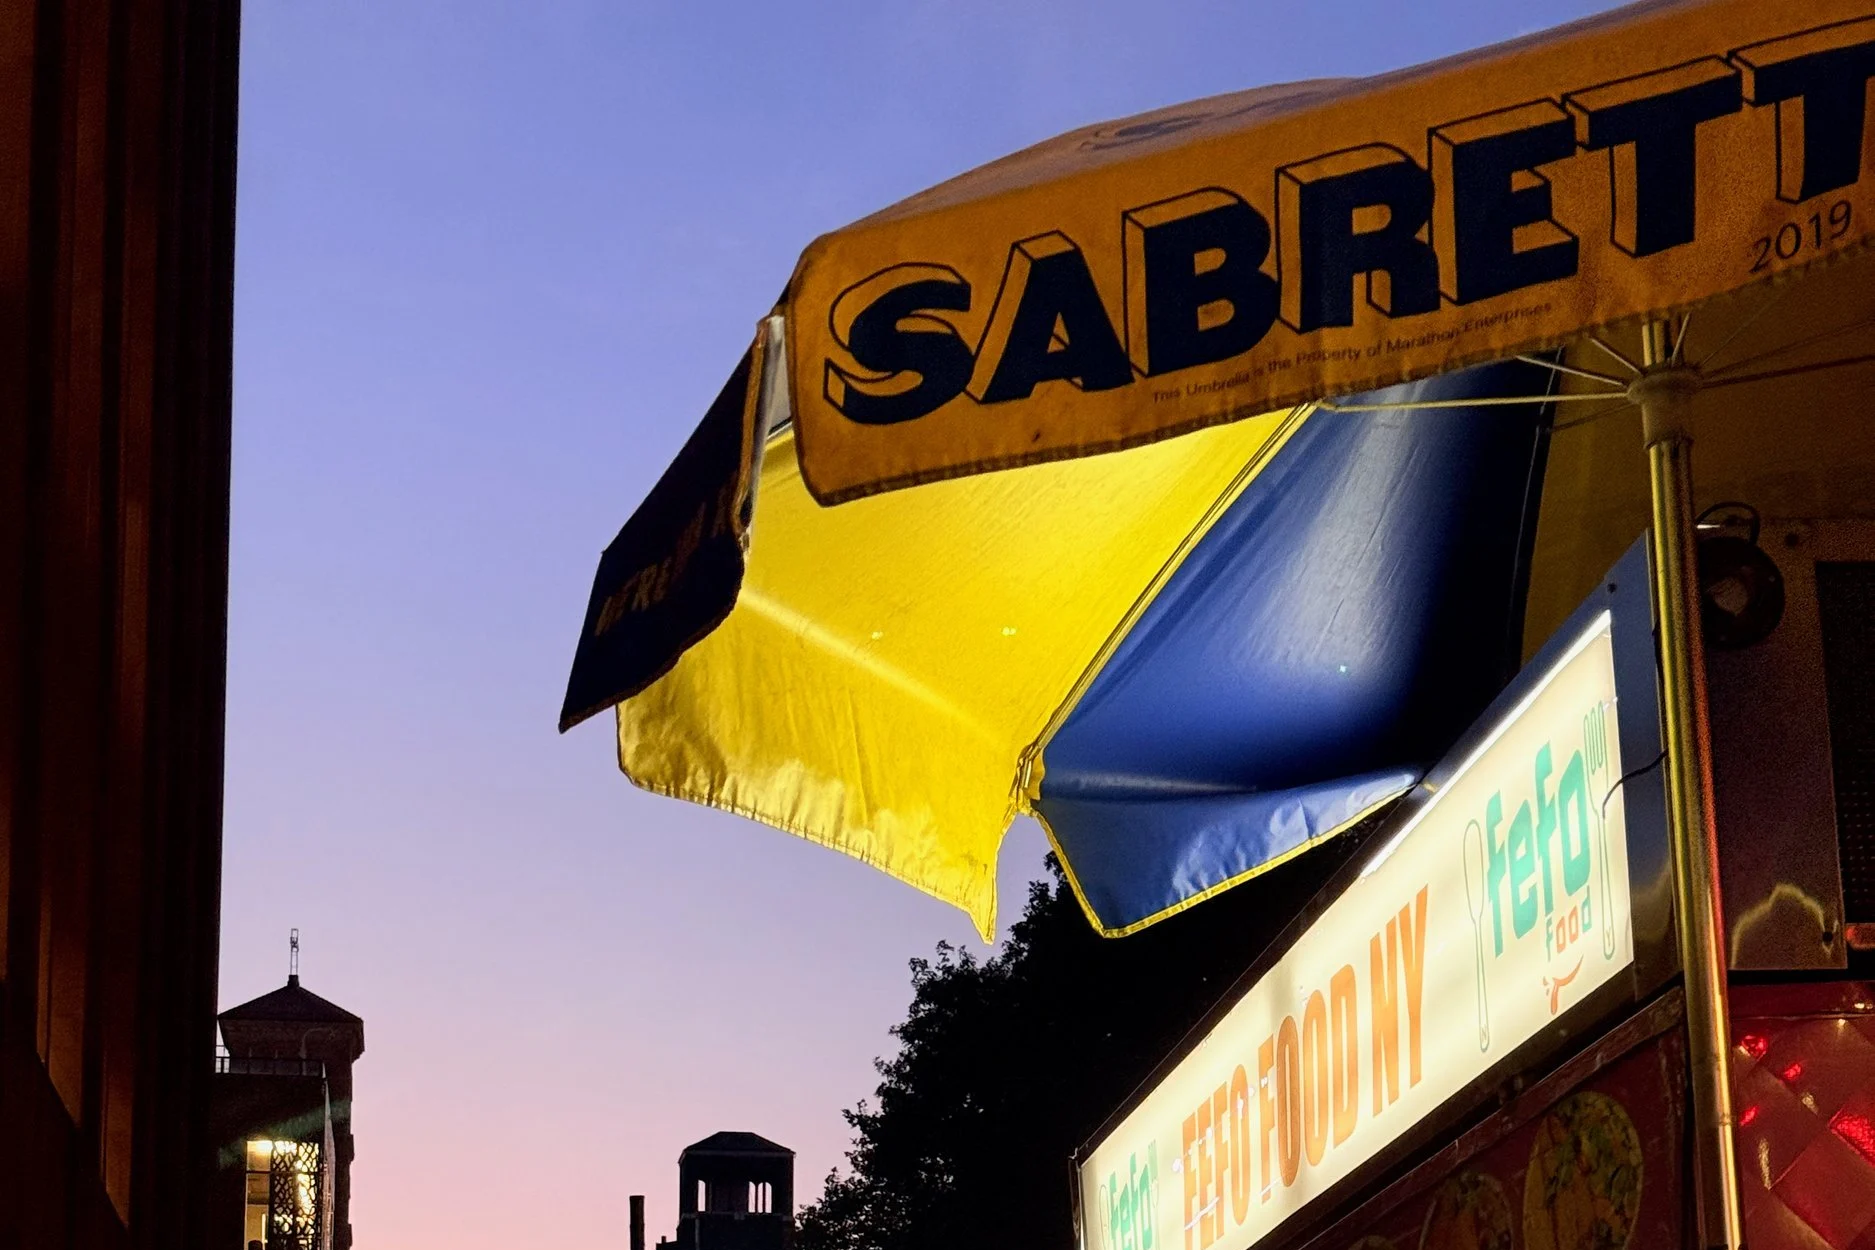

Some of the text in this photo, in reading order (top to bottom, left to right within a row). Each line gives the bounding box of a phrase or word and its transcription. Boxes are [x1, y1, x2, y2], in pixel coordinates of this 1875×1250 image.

[1749, 199, 1852, 274] 2019
[1185, 370, 1250, 398] Umbrella
[1267, 357, 1291, 376] the
[1366, 342, 1383, 358] of
[1385, 326, 1461, 355] Marathon
[1462, 301, 1553, 337] Enterprises
[1485, 739, 1592, 960] fefo
[1257, 963, 1359, 1206] FOOD
[1369, 882, 1429, 1119] NY
